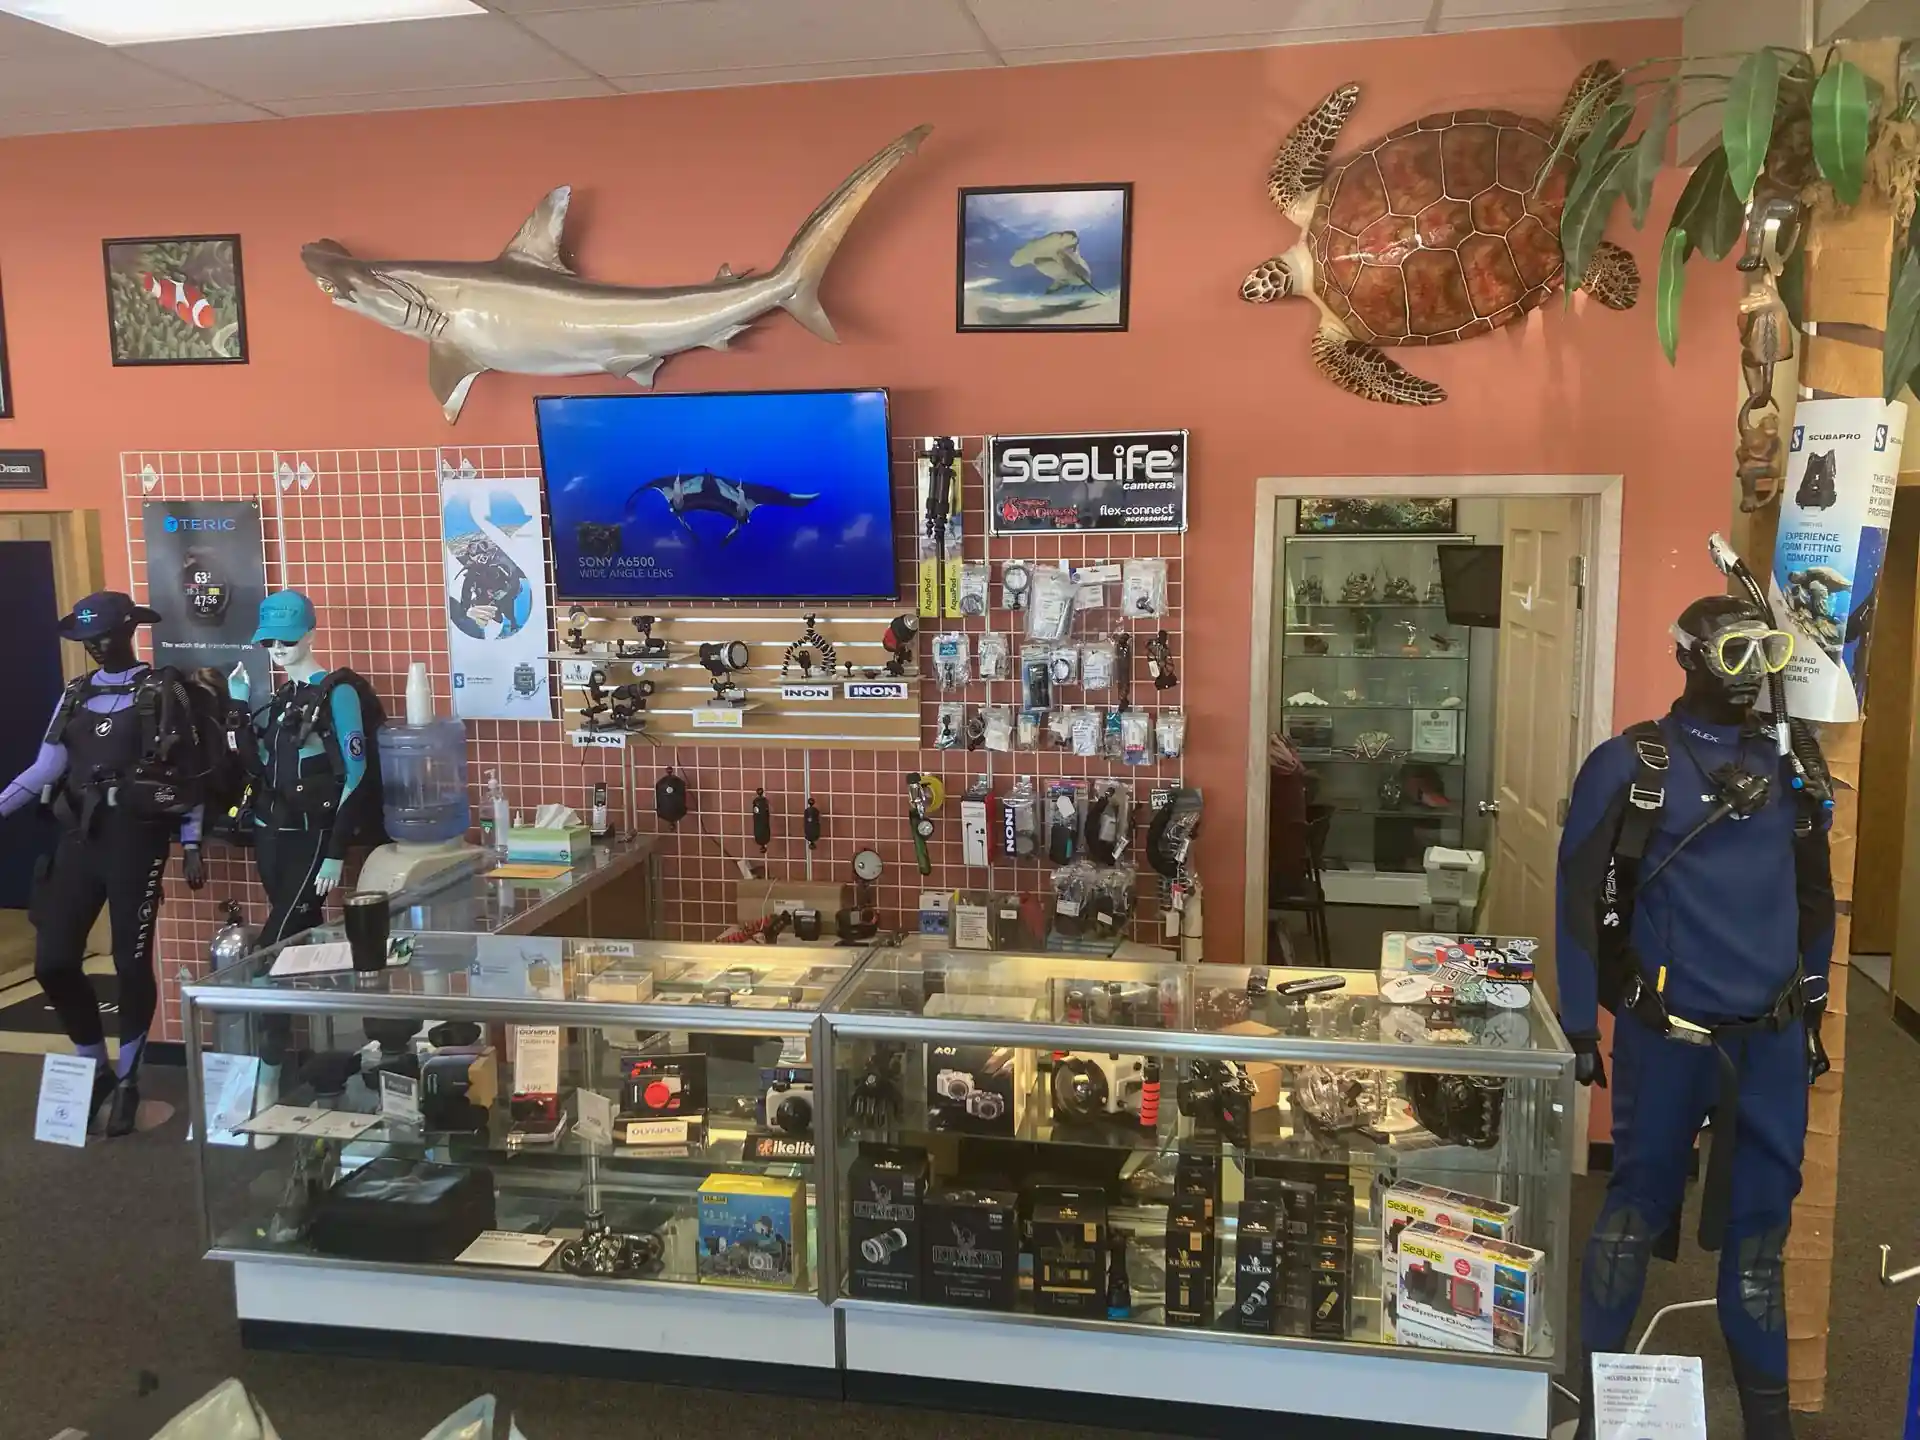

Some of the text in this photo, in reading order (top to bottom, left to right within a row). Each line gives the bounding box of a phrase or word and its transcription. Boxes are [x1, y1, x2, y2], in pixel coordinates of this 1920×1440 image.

[1808, 433, 1861, 441] SCUBAPRO
[0, 464, 31, 473] Dream
[1100, 504, 1174, 516] flex-connect
[179, 518, 236, 531] TERIC
[1786, 531, 1840, 542] EXPERIENCE
[1803, 543, 1842, 553] FITTING
[578, 556, 655, 567] SONY A6500
[1786, 552, 1829, 563] COMFORT
[580, 568, 674, 578] WIDE ANGLE LENS
[1799, 656, 1817, 665] AND
[1803, 666, 1820, 675] FOR
[784, 689, 830, 697] INON
[853, 686, 897, 696] INON
[1004, 808, 1015, 852] INON
[631, 1125, 683, 1136] OLYMPUS
[1387, 1200, 1425, 1217] SeaLife
[1402, 1243, 1442, 1259] SeaLife
[1240, 1264, 1272, 1274] KRAKEN
